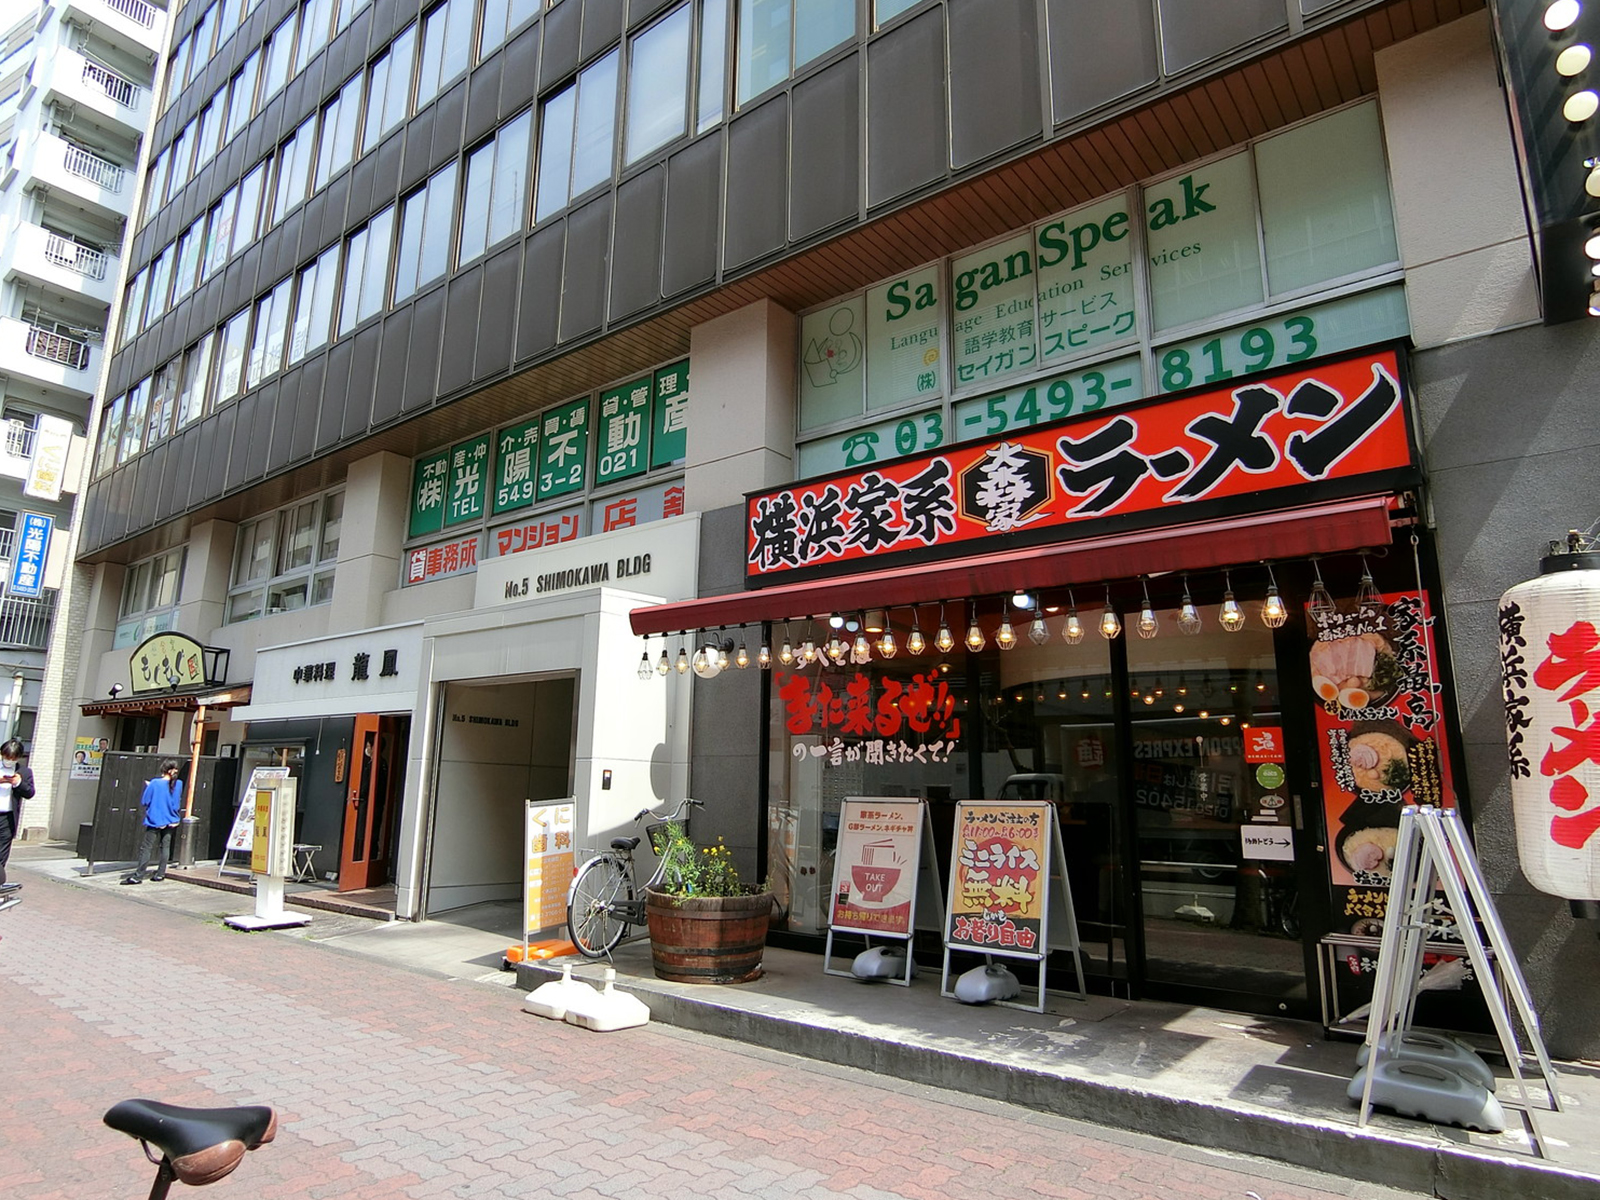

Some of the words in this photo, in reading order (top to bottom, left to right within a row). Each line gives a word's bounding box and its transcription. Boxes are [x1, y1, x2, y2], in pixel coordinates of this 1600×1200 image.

[965, 290, 1117, 356] 語学教育サービス
[957, 310, 1135, 382] セイガンスピーク
[749, 458, 957, 571] 横浜家系
[1058, 362, 1400, 517] ラーメン
[452, 498, 479, 517] TEL
[409, 538, 477, 583] 貸事務所
[498, 515, 579, 556] マンション
[505, 578, 529, 598] No.5
[536, 562, 609, 592] SHIMOKAWA
[616, 553, 651, 578] BLDG
[293, 662, 336, 684] 中華料理
[1360, 789, 1402, 804] ラーメン
[532, 807, 570, 827] くに
[532, 830, 571, 853] 歯科
[959, 838, 1040, 871] ミニライス
[864, 872, 886, 881] TAKE
[865, 882, 883, 893] OUT
[962, 869, 1034, 914] 無料
